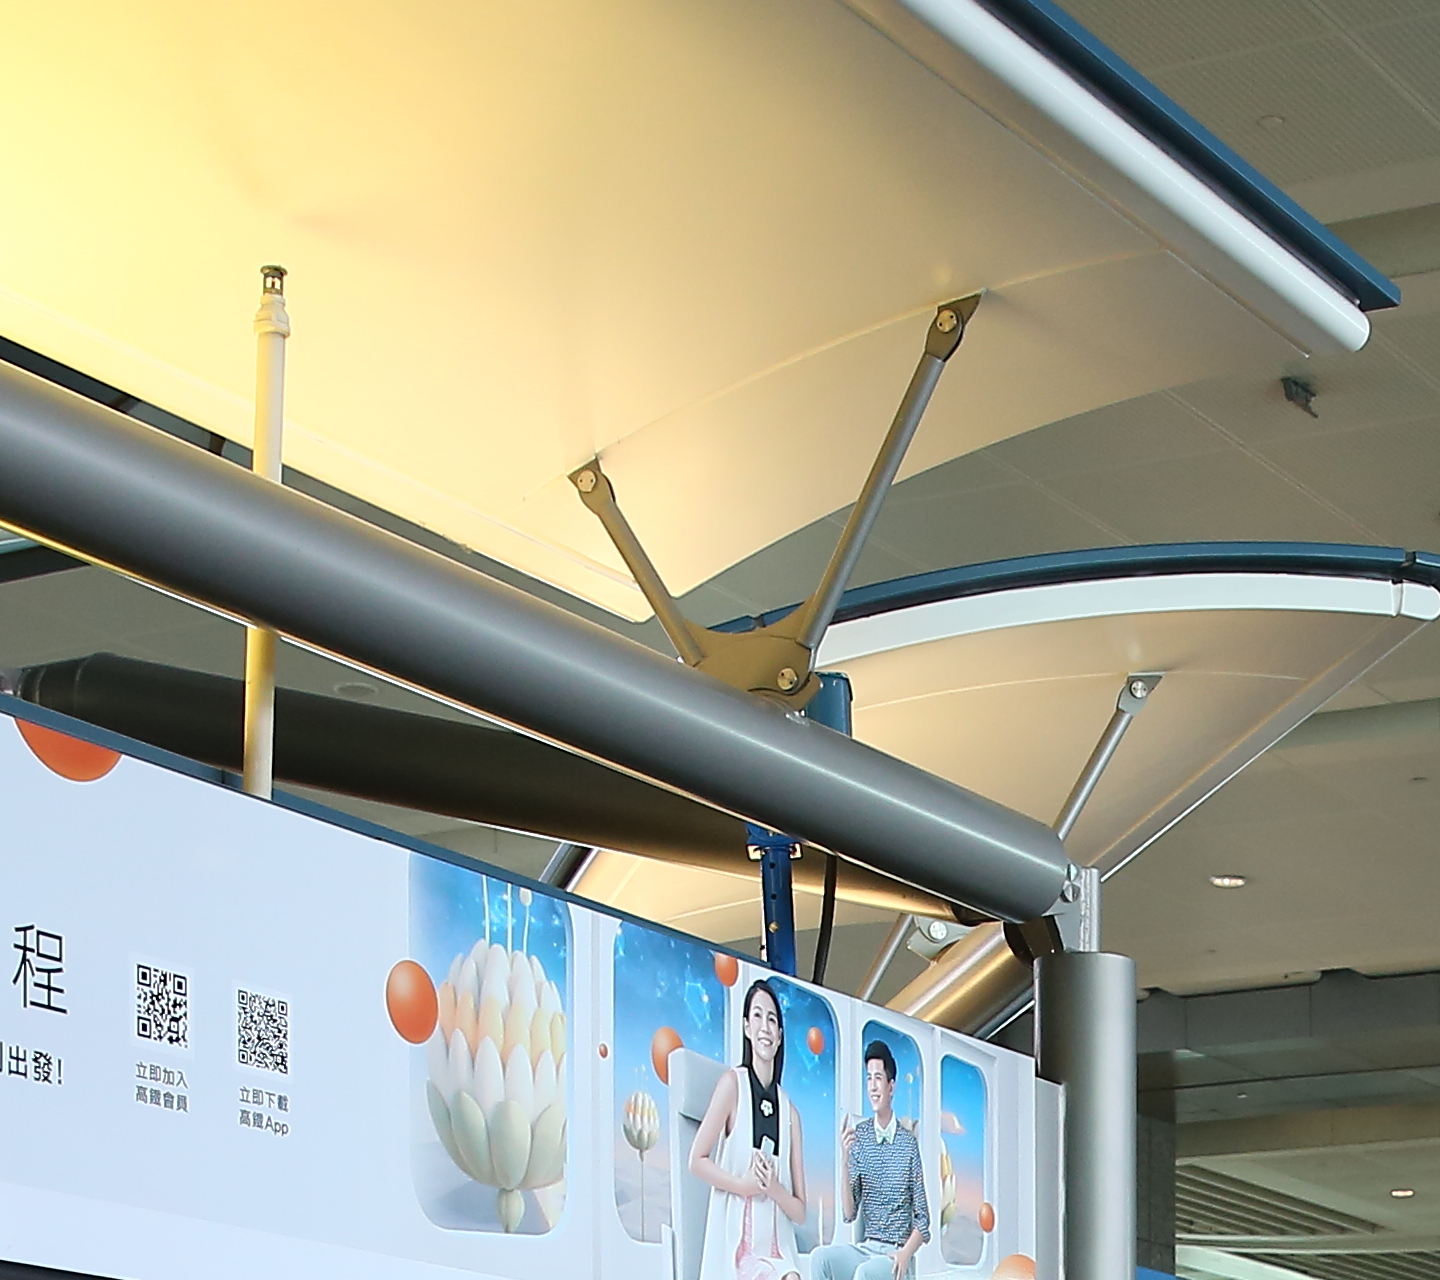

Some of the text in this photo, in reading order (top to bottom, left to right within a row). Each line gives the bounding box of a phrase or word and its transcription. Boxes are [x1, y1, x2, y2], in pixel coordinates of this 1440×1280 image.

[135, 1061, 189, 1090] 立即加入
[238, 1086, 289, 1114] 立即下載
